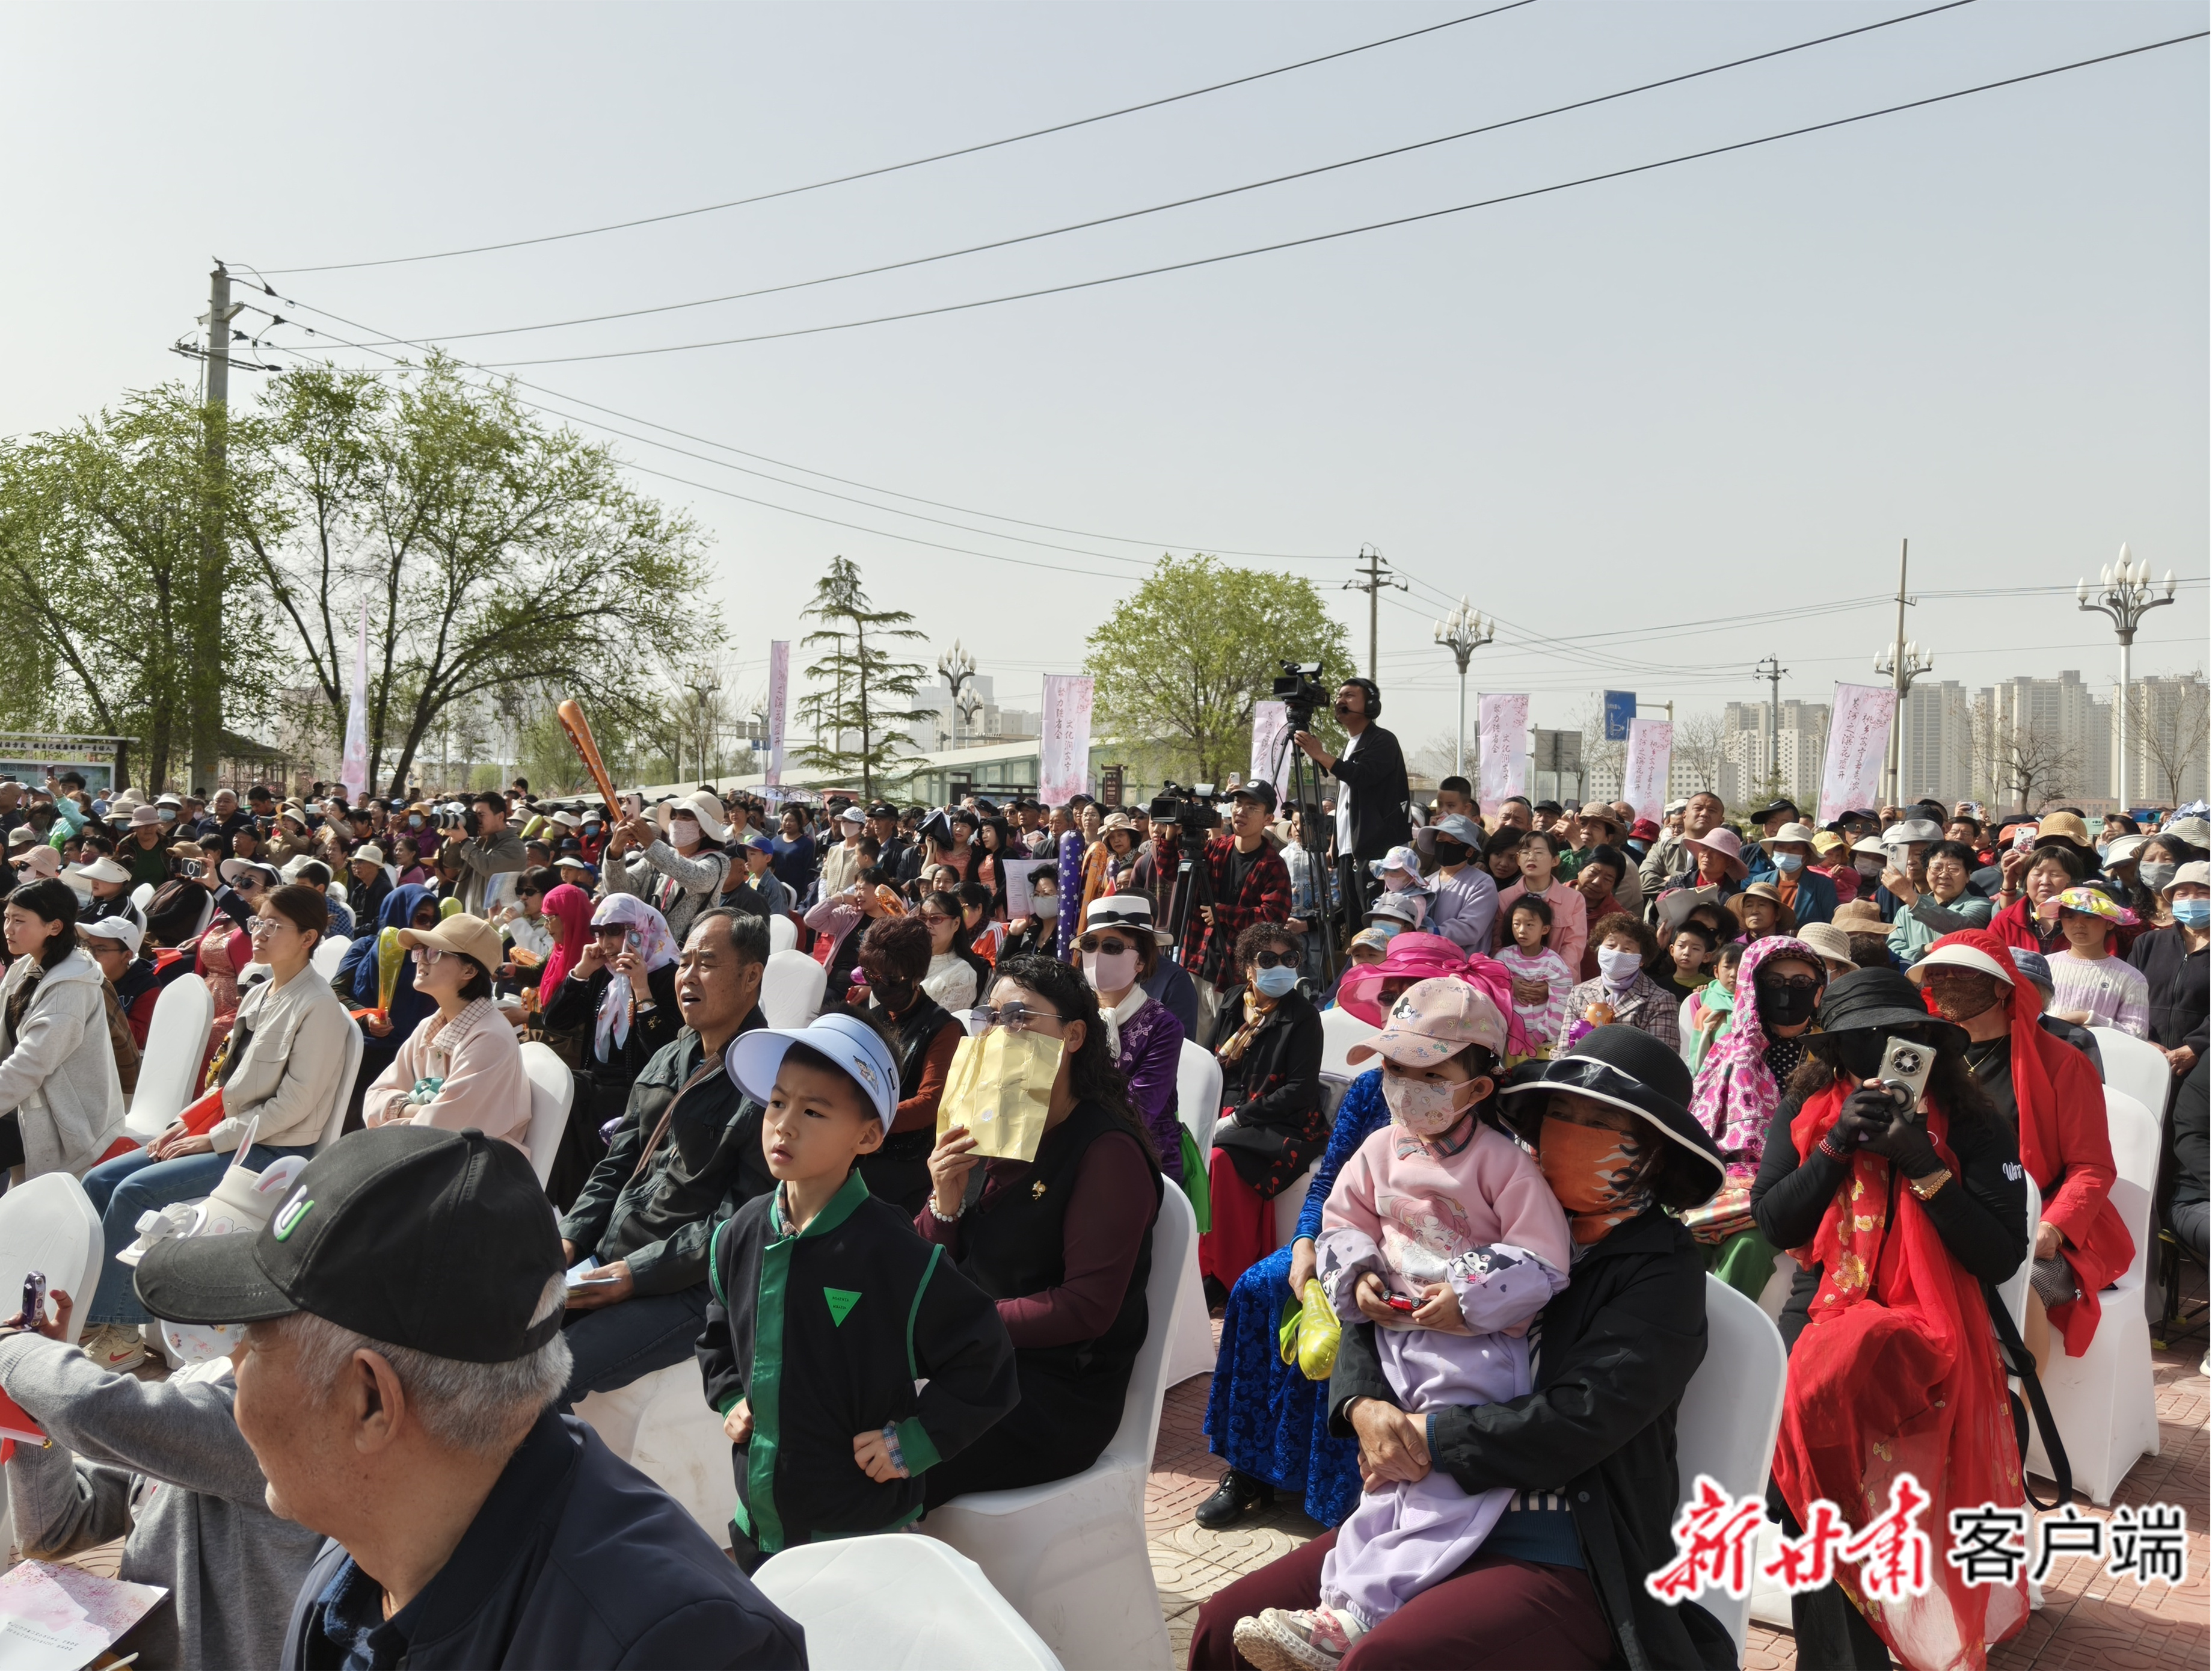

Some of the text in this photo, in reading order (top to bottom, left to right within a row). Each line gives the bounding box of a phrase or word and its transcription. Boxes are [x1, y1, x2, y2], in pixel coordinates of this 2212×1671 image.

[1837, 697, 1860, 781] 黄河之滨花盛开
